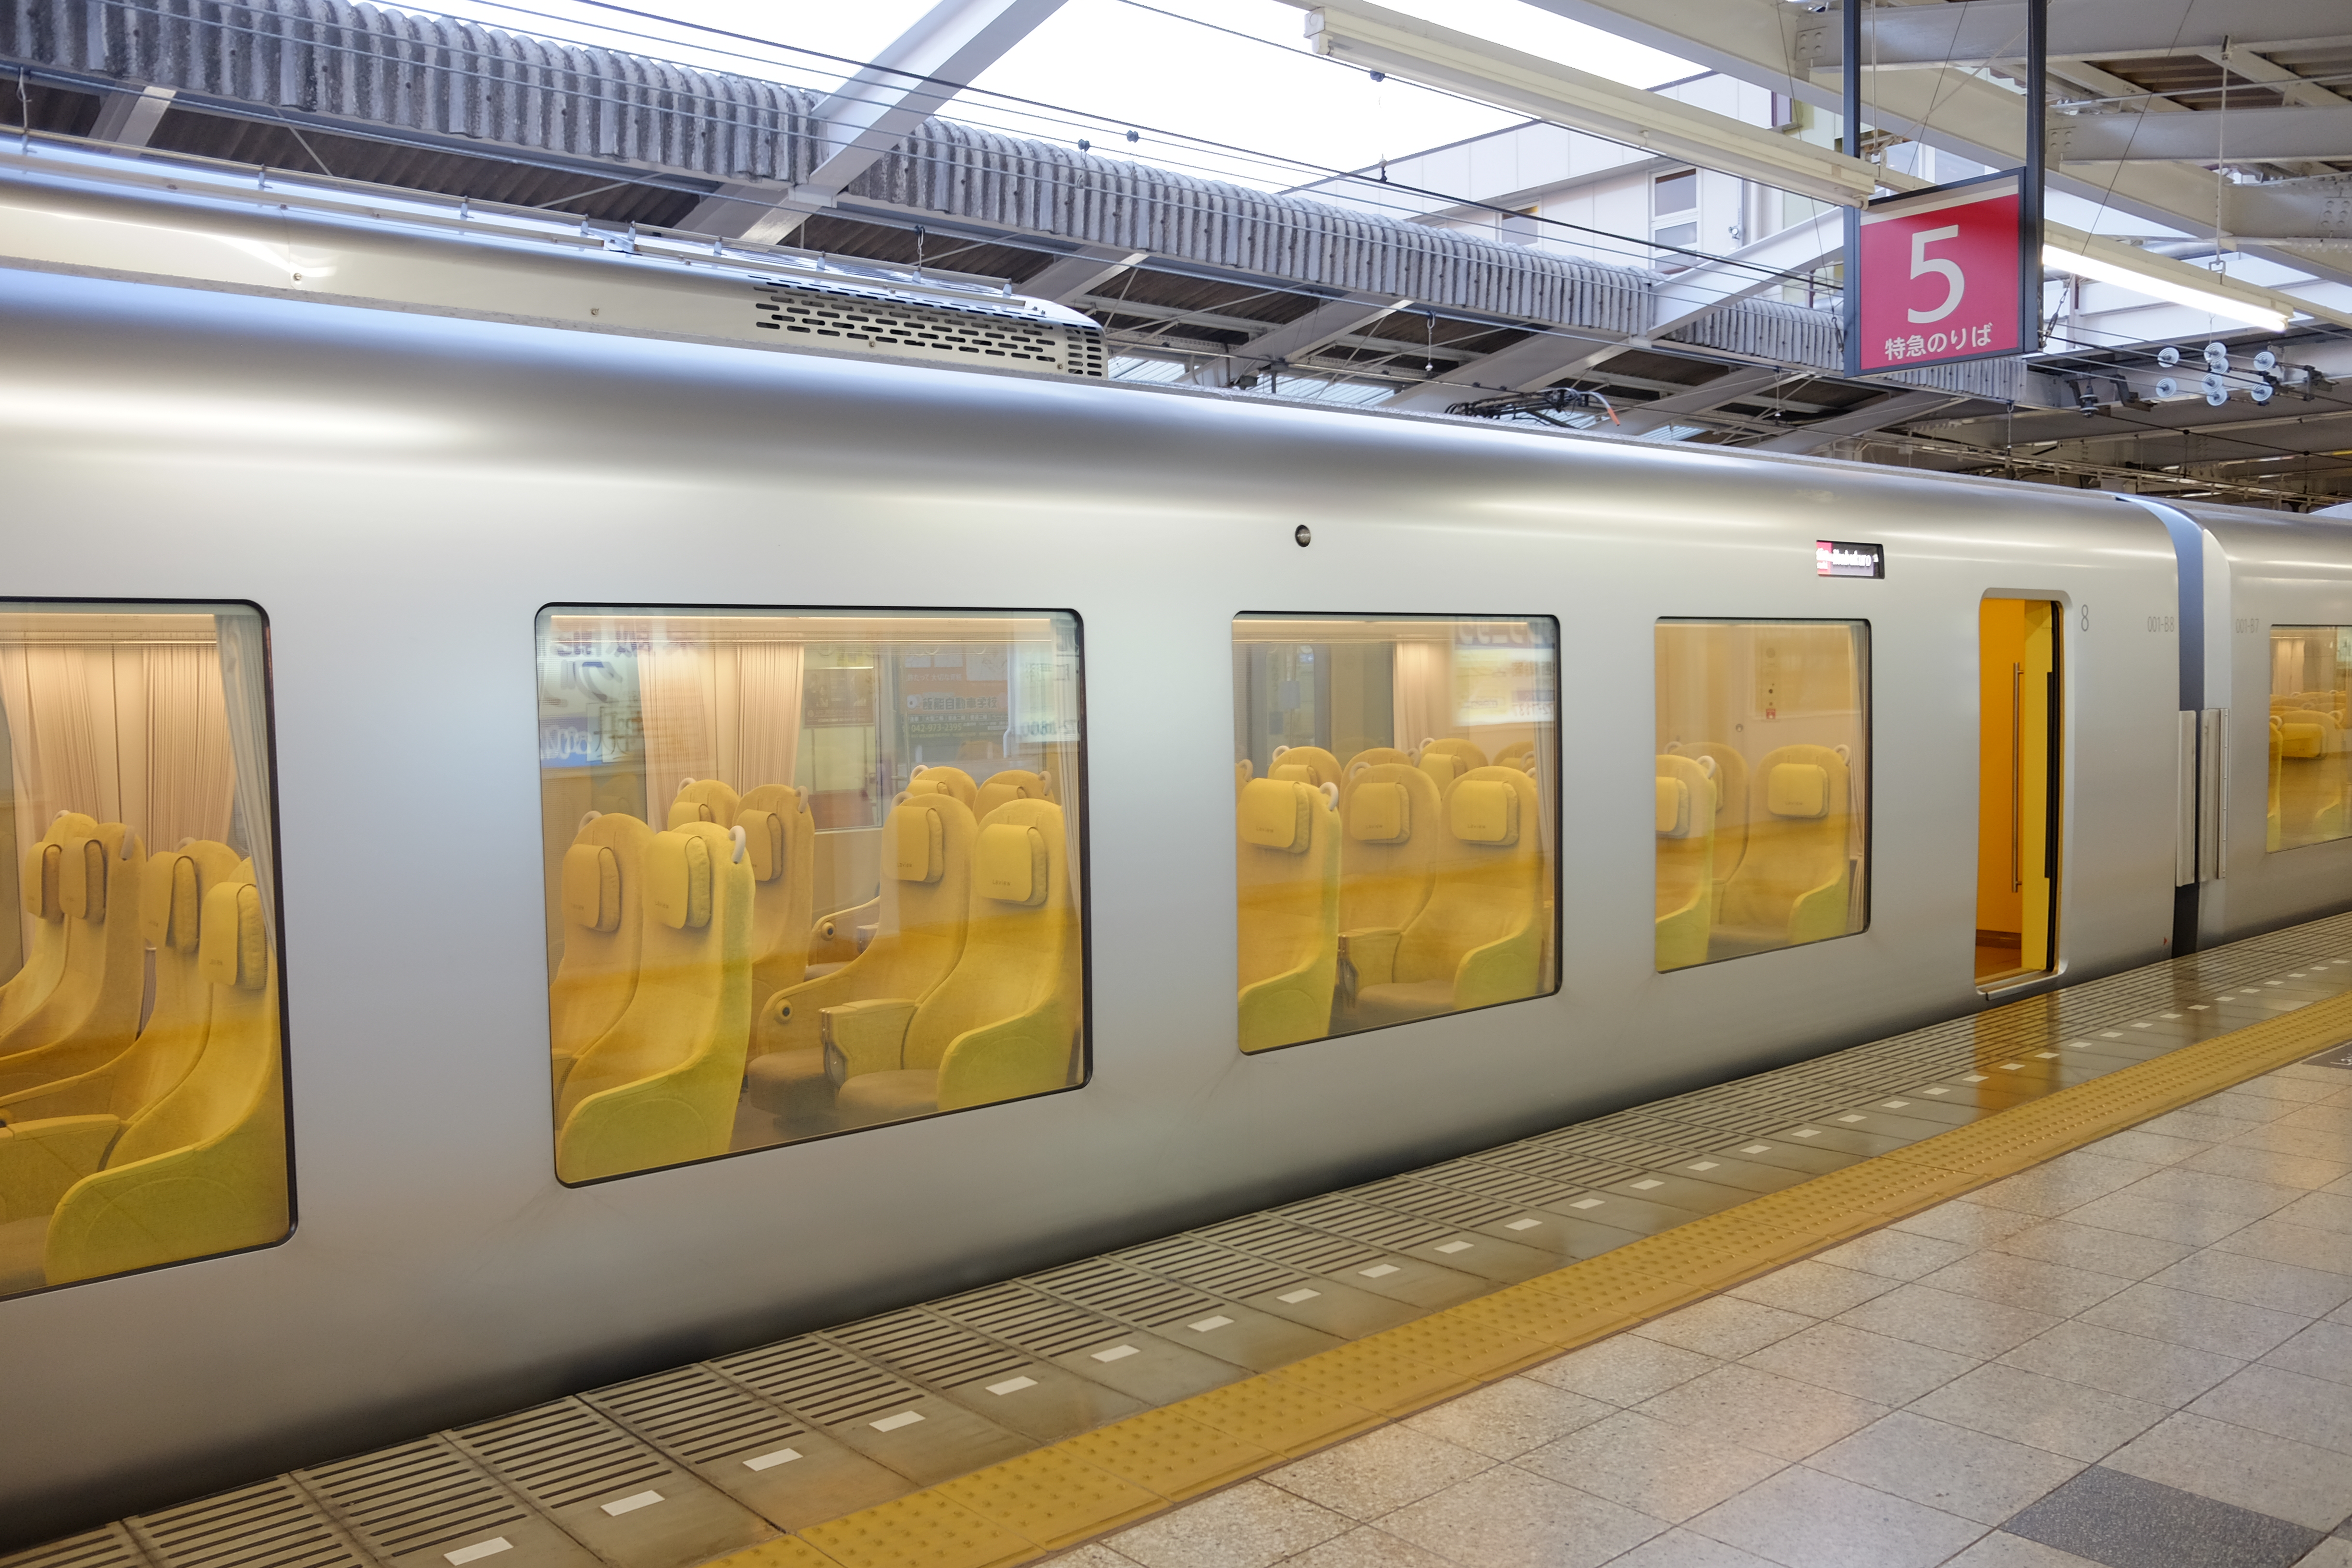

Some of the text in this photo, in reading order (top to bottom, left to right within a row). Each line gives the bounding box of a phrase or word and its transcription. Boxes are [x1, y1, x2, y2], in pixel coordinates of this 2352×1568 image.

[1907, 224, 1965, 324] 5
[1885, 321, 1994, 361] 特急のりば
[2081, 604, 2089, 632] 8
[2147, 616, 2175, 633] 001-B8
[2235, 618, 2259, 634] 001-B7
[922, 697, 998, 710] 飯能自動車学校
[911, 723, 962, 732] 042-973-2395
